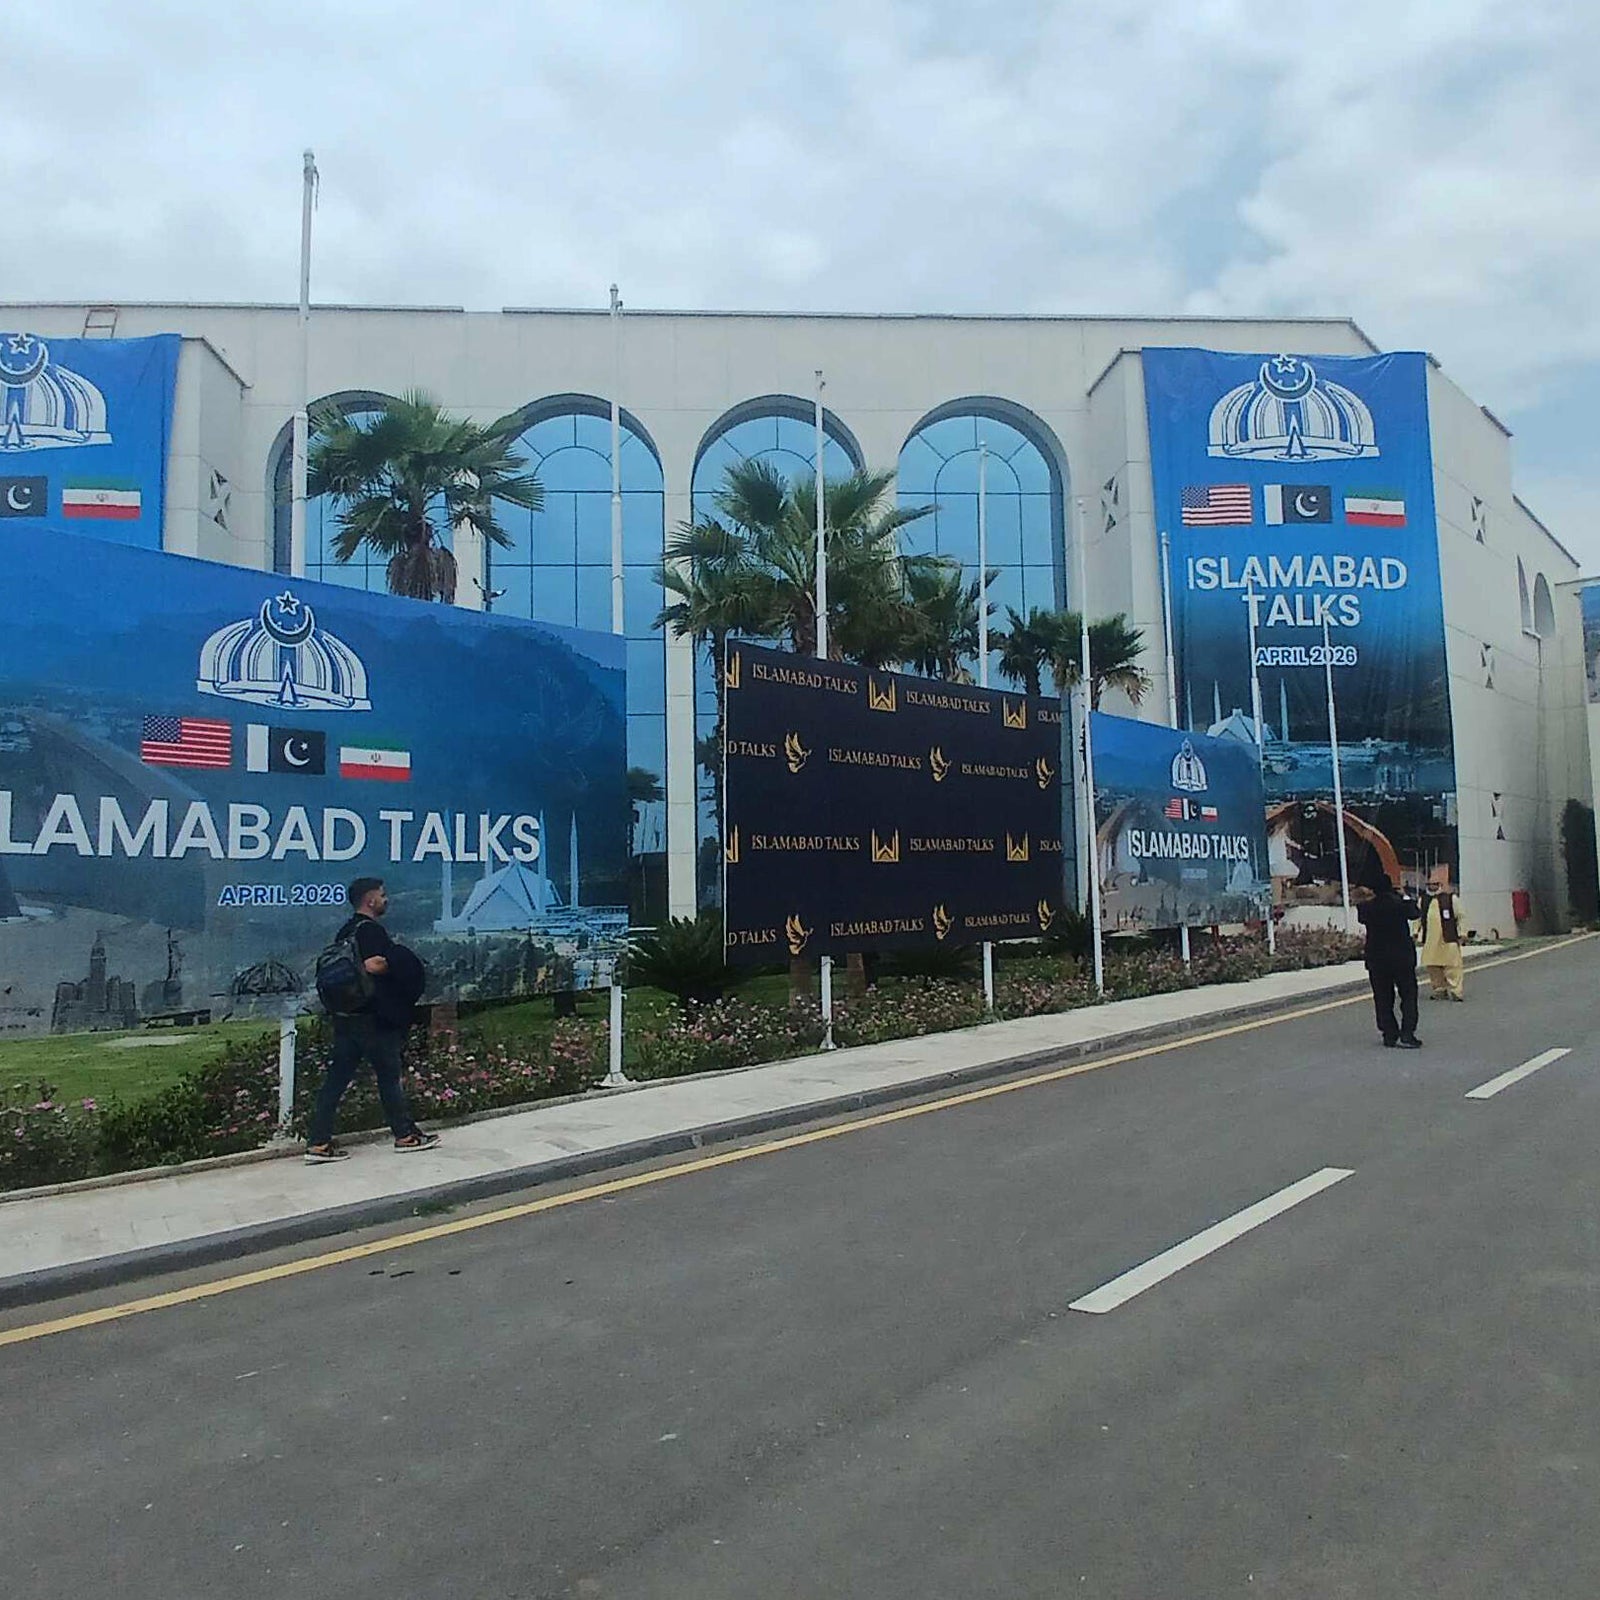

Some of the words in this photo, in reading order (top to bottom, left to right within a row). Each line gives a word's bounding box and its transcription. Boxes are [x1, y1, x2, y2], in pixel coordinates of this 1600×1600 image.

[1187, 555, 1408, 590] ISLAMABAD
[1242, 594, 1361, 627] TALKS
[1256, 647, 1309, 666] APRIL
[1310, 646, 1358, 666] 2026
[752, 663, 822, 688] ISLAMABAD
[824, 676, 859, 694] TALKS
[906, 690, 962, 710] ISLAMABAD
[963, 699, 991, 714] TALKS
[740, 742, 777, 757] TALKS
[828, 748, 890, 767] ISLAMABAD
[892, 755, 922, 770] TALKS
[961, 763, 1005, 777] ISLAMABAD
[1006, 766, 1029, 779] TALKS
[0, 790, 367, 861] LAMABAD
[379, 810, 541, 862] TALKS
[751, 834, 823, 850] ISLAMABAD
[825, 837, 860, 850] TALKS
[910, 838, 965, 851] ISLAMABAD
[966, 839, 994, 850] TALKS
[1127, 829, 1210, 859] ISLAMABAD
[1211, 835, 1249, 859] TALKS
[218, 884, 287, 906] APRIL
[292, 884, 346, 905] 2026
[830, 920, 893, 937] ISLAMABAD
[894, 918, 924, 932] TALKS
[965, 914, 1008, 927] ISLAMABAD
[1008, 913, 1031, 924] TALKS
[739, 929, 777, 945] TALKS
